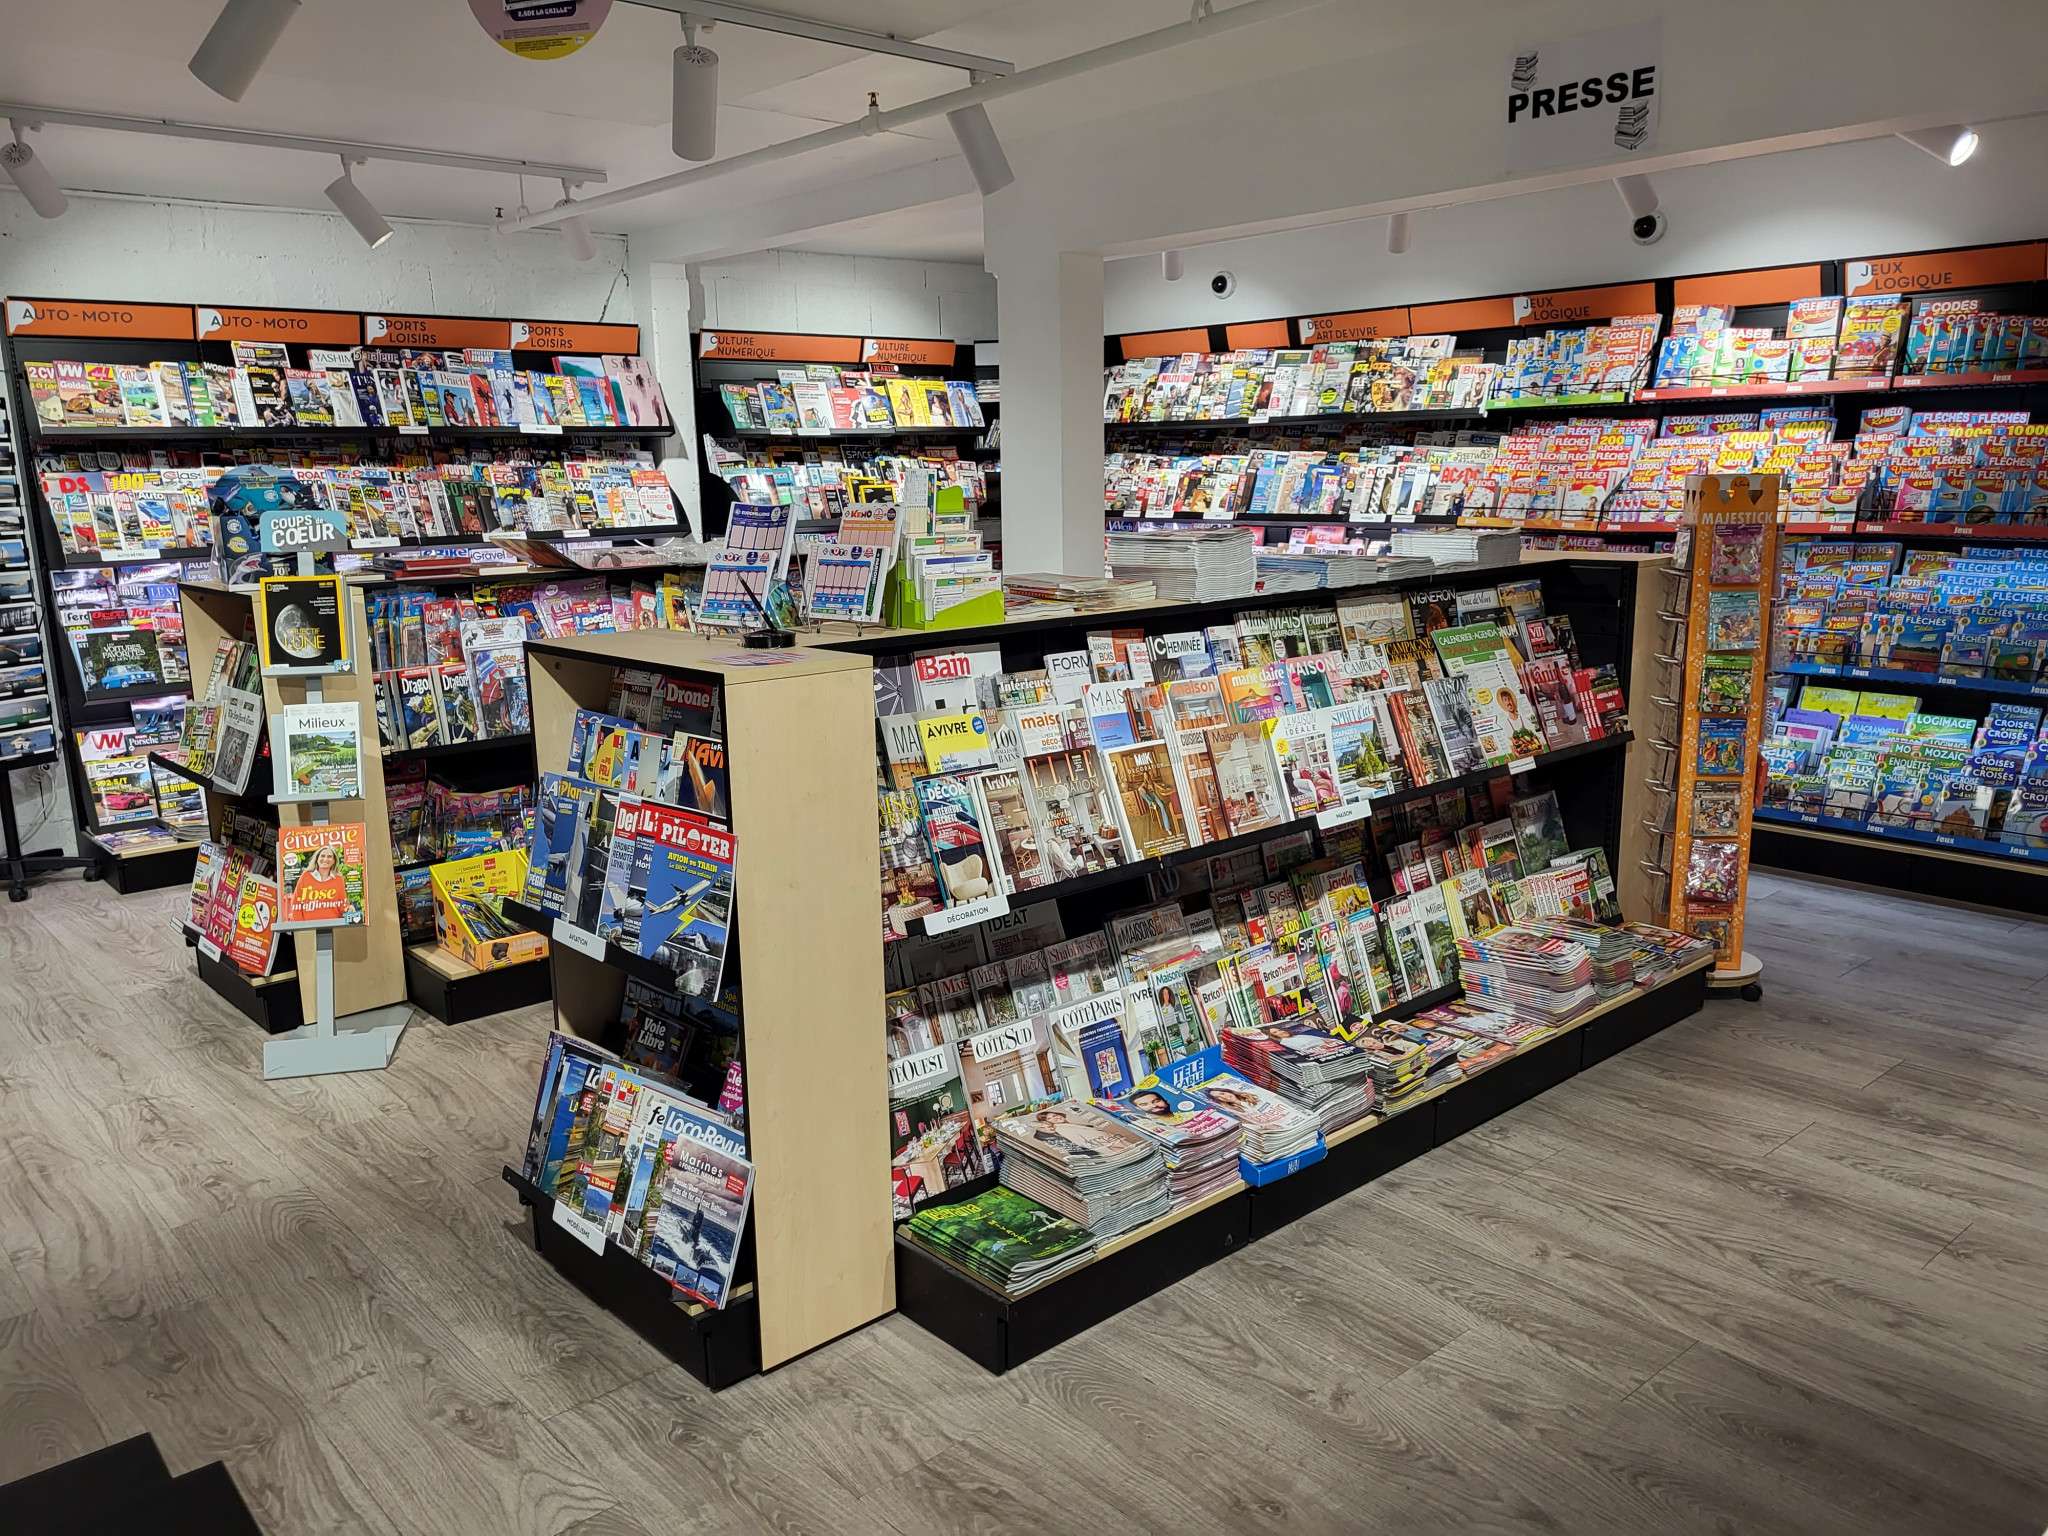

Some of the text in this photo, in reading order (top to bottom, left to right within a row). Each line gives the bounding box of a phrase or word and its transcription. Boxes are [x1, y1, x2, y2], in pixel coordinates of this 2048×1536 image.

[1508, 66, 1655, 123] PRESSE
[1861, 262, 1903, 276] JEUX
[1874, 273, 1953, 291] LOGIQUE
[1522, 296, 1554, 310] JEUX
[1932, 299, 1978, 313] CODES
[22, 309, 133, 324] AUTO MOTO
[1533, 306, 1590, 320] LOGIQUE
[211, 315, 308, 330] AUTO MOTO
[378, 319, 427, 332] SPORTS
[521, 325, 564, 337] SPORTS
[1316, 331, 1334, 341] ART
[1348, 327, 1378, 338] VIVRE
[1608, 332, 1641, 341] CODES
[389, 332, 437, 345] LOISIRS
[530, 337, 573, 349] LOISIRS
[710, 335, 755, 347] CULTURE
[871, 341, 910, 352] CULTURE
[57, 364, 83, 378] VW
[1462, 365, 1492, 376] Blues
[1714, 414, 1752, 424] SUDOKU
[1600, 436, 1624, 445] 200
[60, 477, 90, 492] DS
[138, 492, 166, 500] Auto
[142, 520, 159, 529] 50
[271, 515, 312, 531] COUPS
[1702, 512, 1773, 525] MAJESTICK
[1410, 590, 1456, 604] VIGNERON
[283, 635, 326, 650] LUNE
[1385, 638, 1432, 655] CAMPAGNE
[1100, 652, 1114, 662] BOIS
[925, 656, 971, 680] Bain
[1344, 658, 1385, 674] CAMPAGNE
[1259, 667, 1284, 683] claire
[1403, 695, 1425, 705] Maison
[299, 718, 345, 730] Milieux
[1917, 714, 1973, 729] LOGIMAGE
[92, 732, 125, 750] VW
[129, 736, 159, 747] Porsche
[993, 729, 1016, 750] 100
[1212, 731, 1239, 743] Maison
[1028, 749, 1097, 789] ELLE
[1844, 764, 1873, 776] JEUX
[1840, 776, 1871, 787] JEUX
[284, 829, 358, 850] énergie
[231, 854, 241, 871] 60
[668, 852, 718, 873] AVION TRAIN
[246, 881, 257, 893] 60
[1558, 886, 1576, 897] 2024
[947, 907, 989, 923] DÉCORATION
[987, 910, 1028, 931] IDEAT
[1283, 920, 1299, 933] 100
[568, 934, 588, 947] AVIATION
[644, 1017, 666, 1036] Voie
[638, 1030, 665, 1051] Libre
[680, 1150, 723, 1178] Marines
